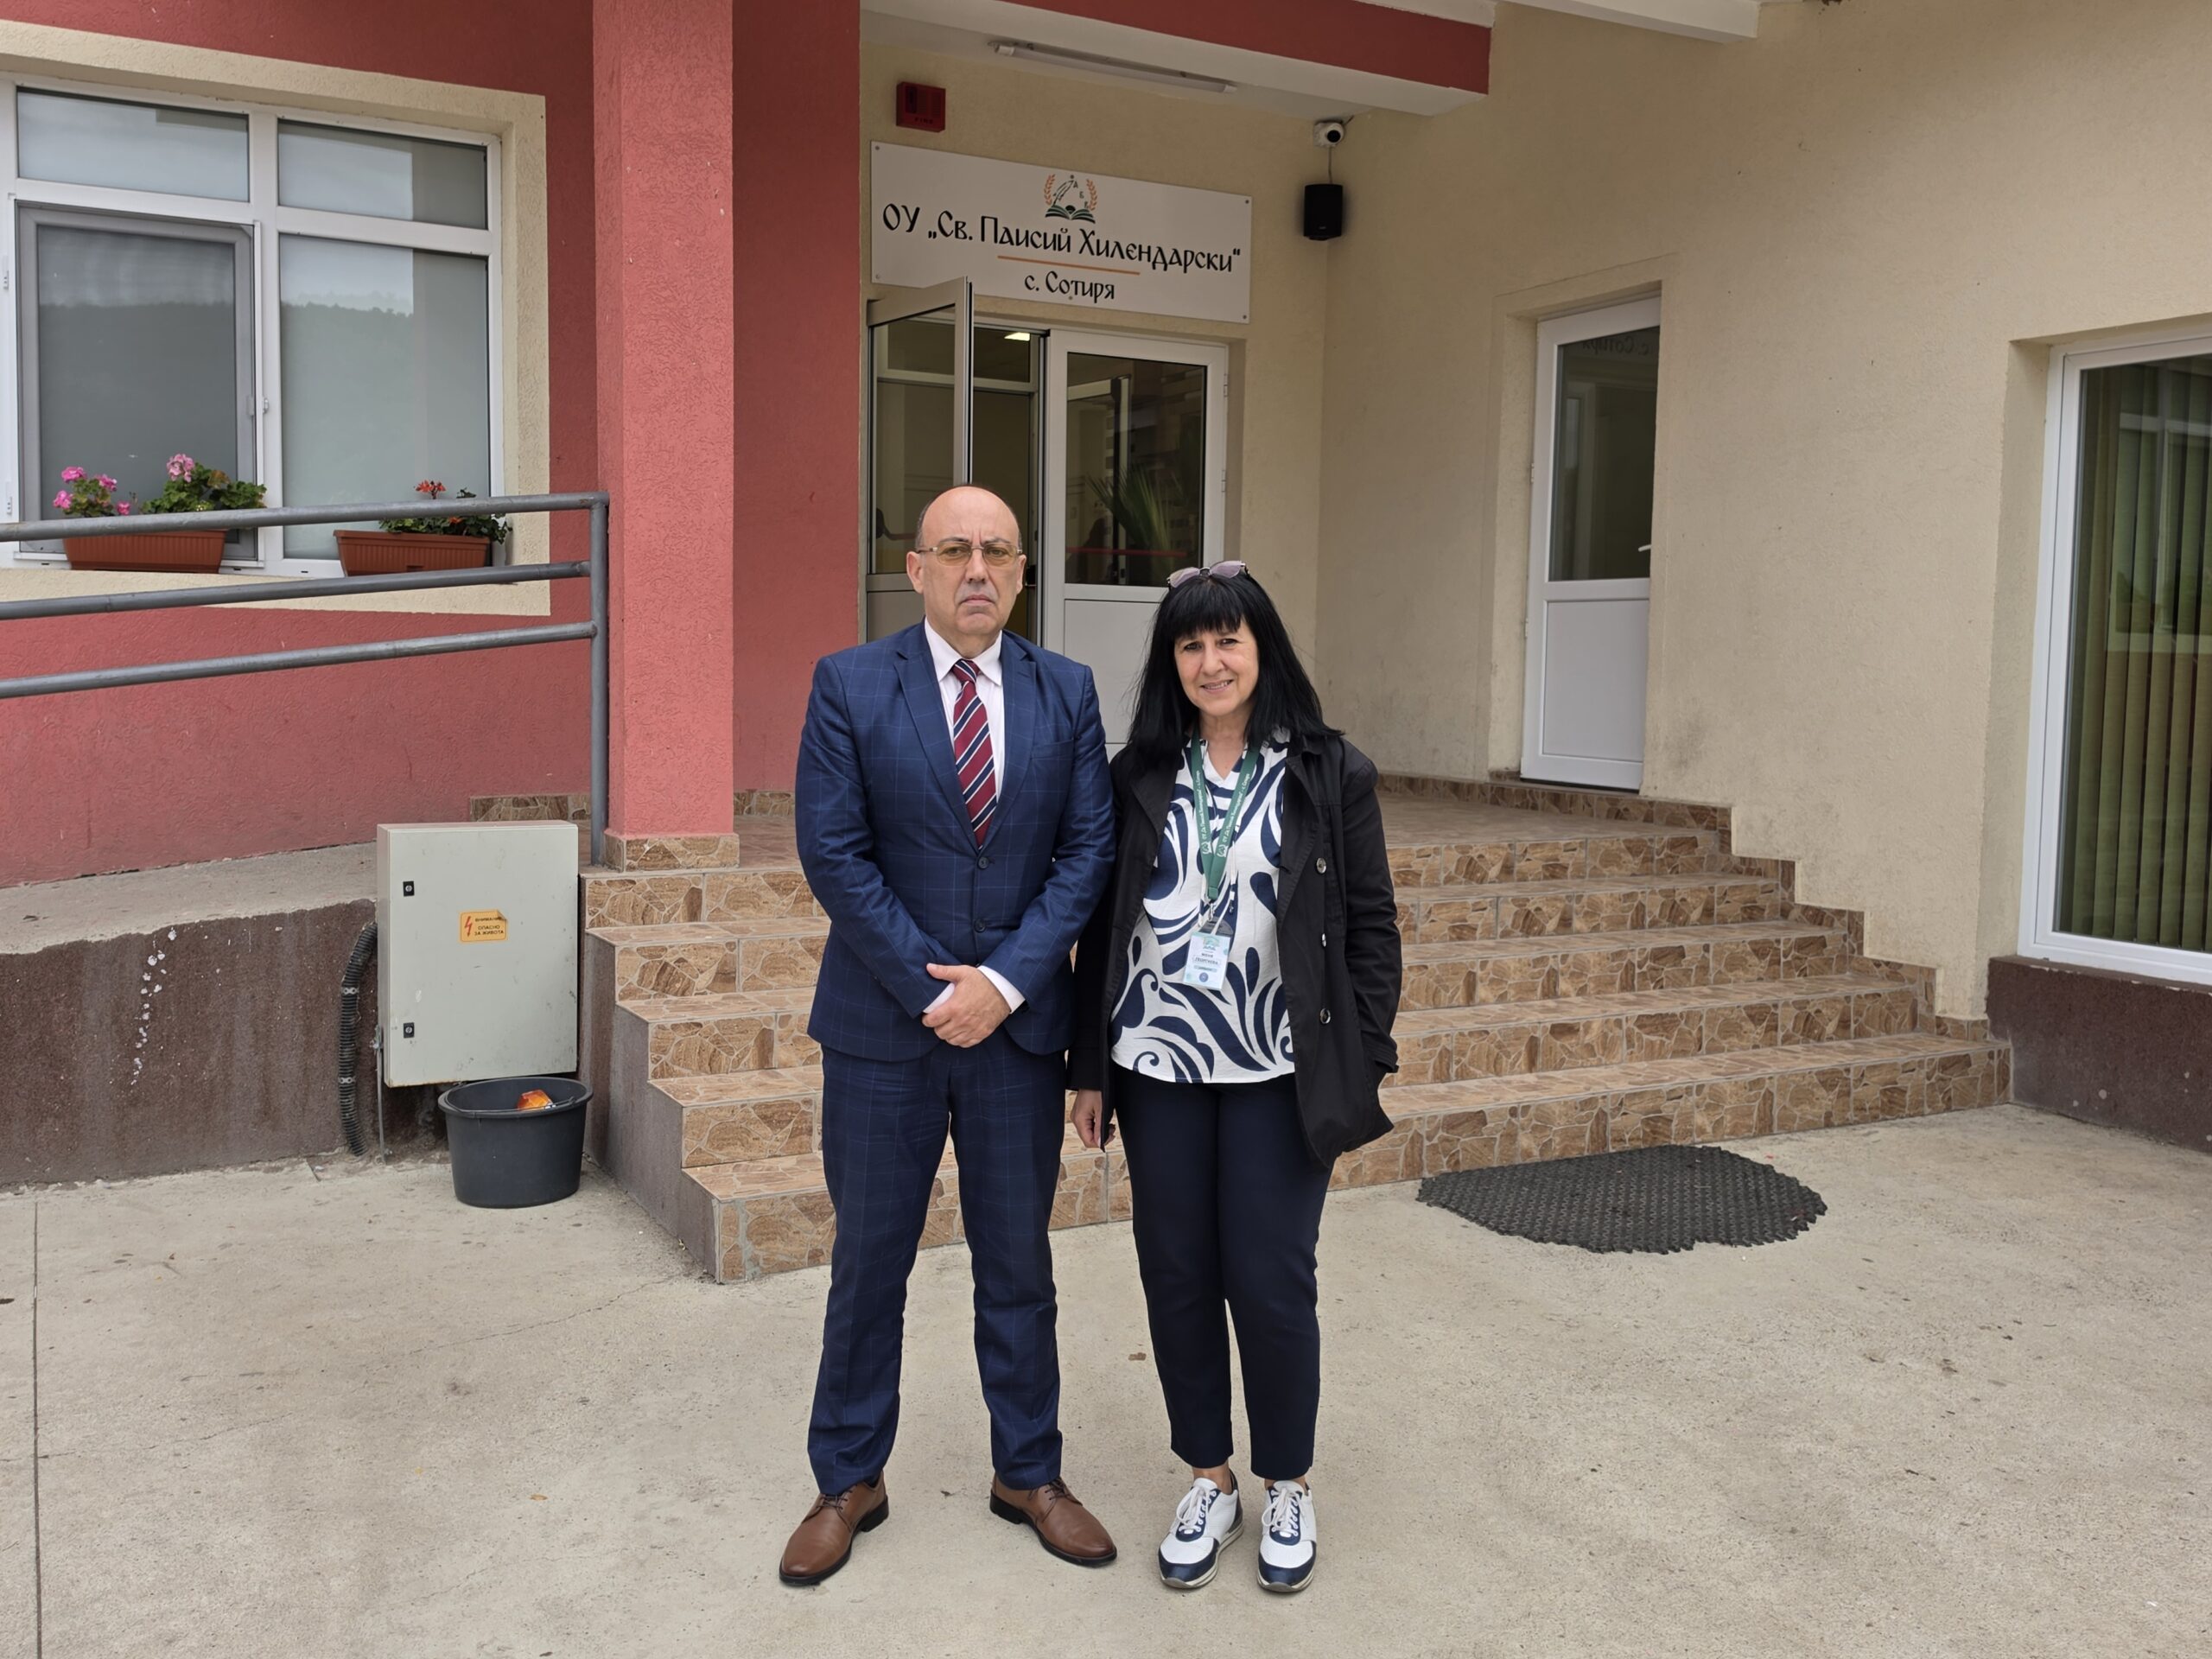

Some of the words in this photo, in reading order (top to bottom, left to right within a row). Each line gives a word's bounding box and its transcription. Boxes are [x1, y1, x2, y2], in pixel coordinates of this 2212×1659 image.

[882, 203, 920, 232] ОУ
[928, 210, 973, 240] „Св.
[981, 215, 1071, 253] Паисий
[1024, 275, 1039, 291] с.
[1046, 270, 1115, 303] Сотиря
